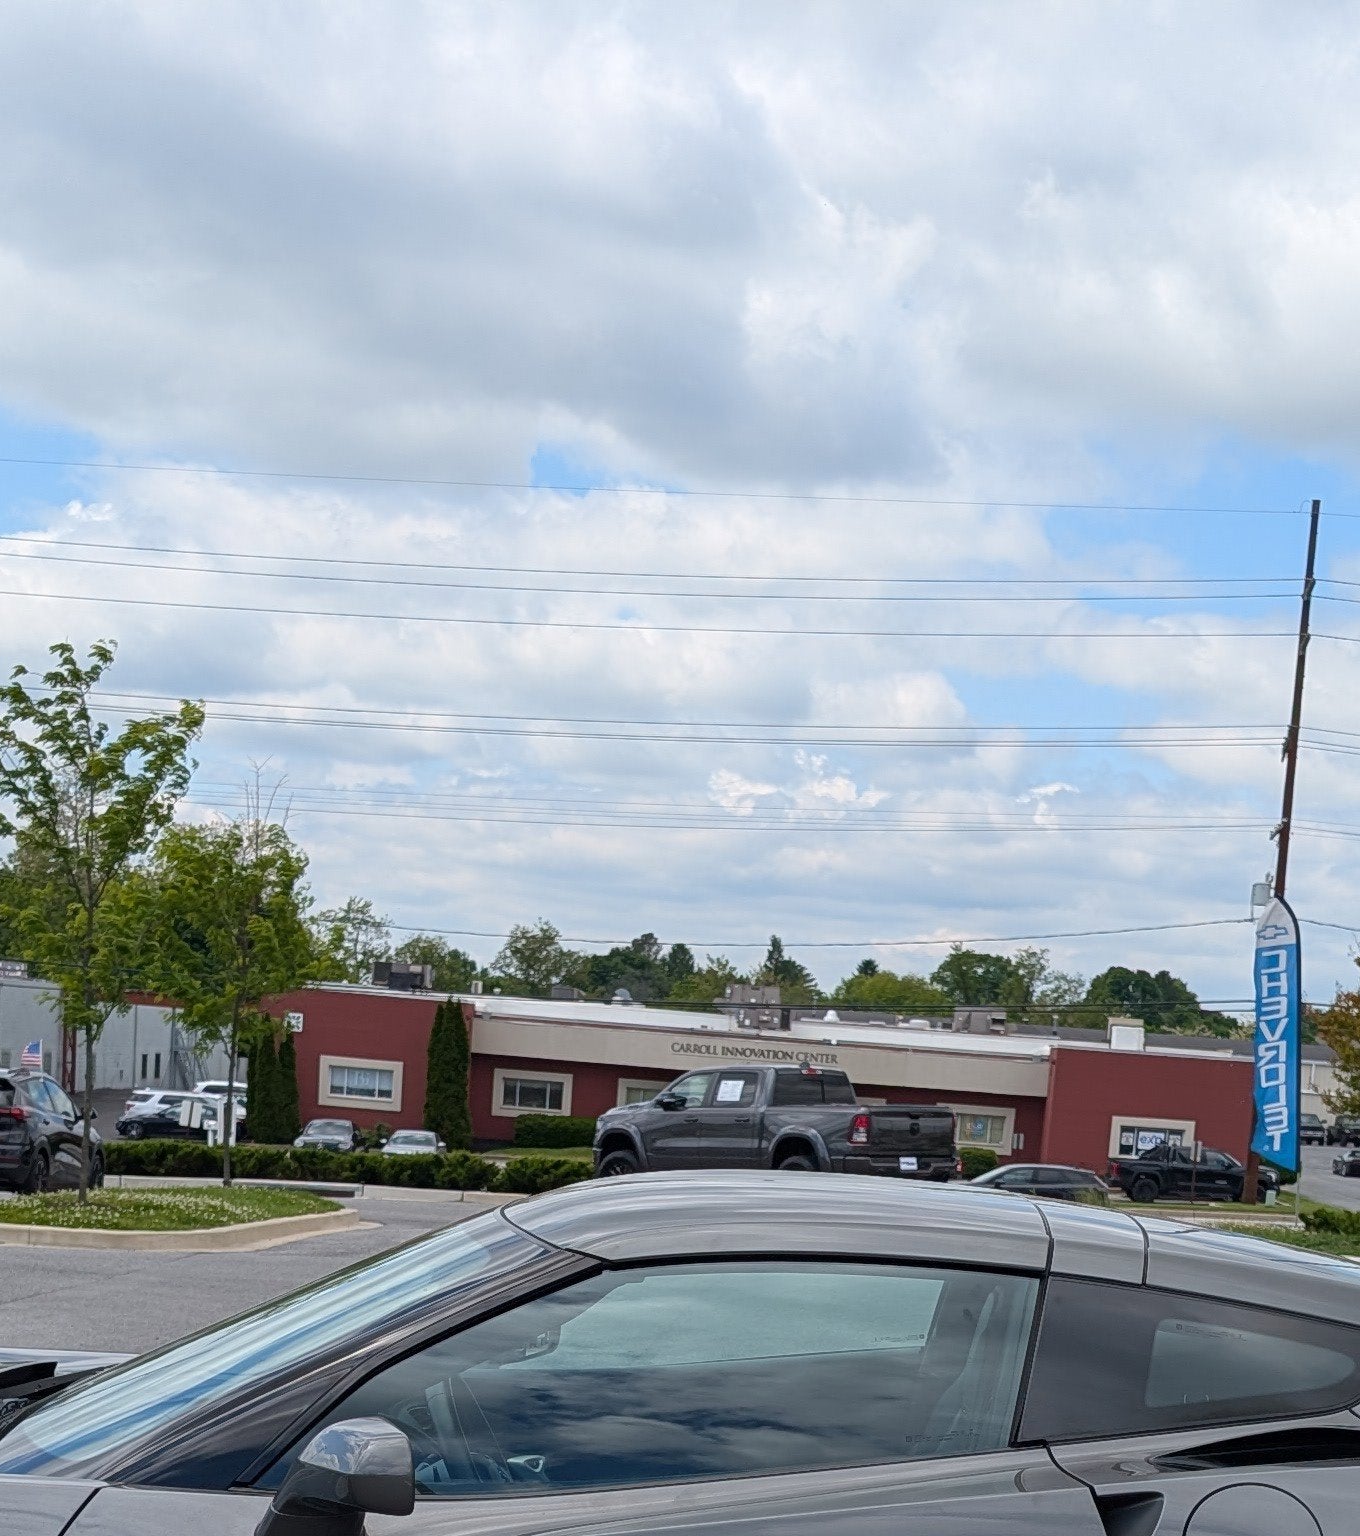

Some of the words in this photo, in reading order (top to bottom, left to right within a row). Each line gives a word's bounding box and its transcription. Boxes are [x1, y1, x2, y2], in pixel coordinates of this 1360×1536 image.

[671, 1042, 718, 1056] CARROLL
[721, 1046, 795, 1062] INNOVATION
[796, 1051, 838, 1064] CENTER
